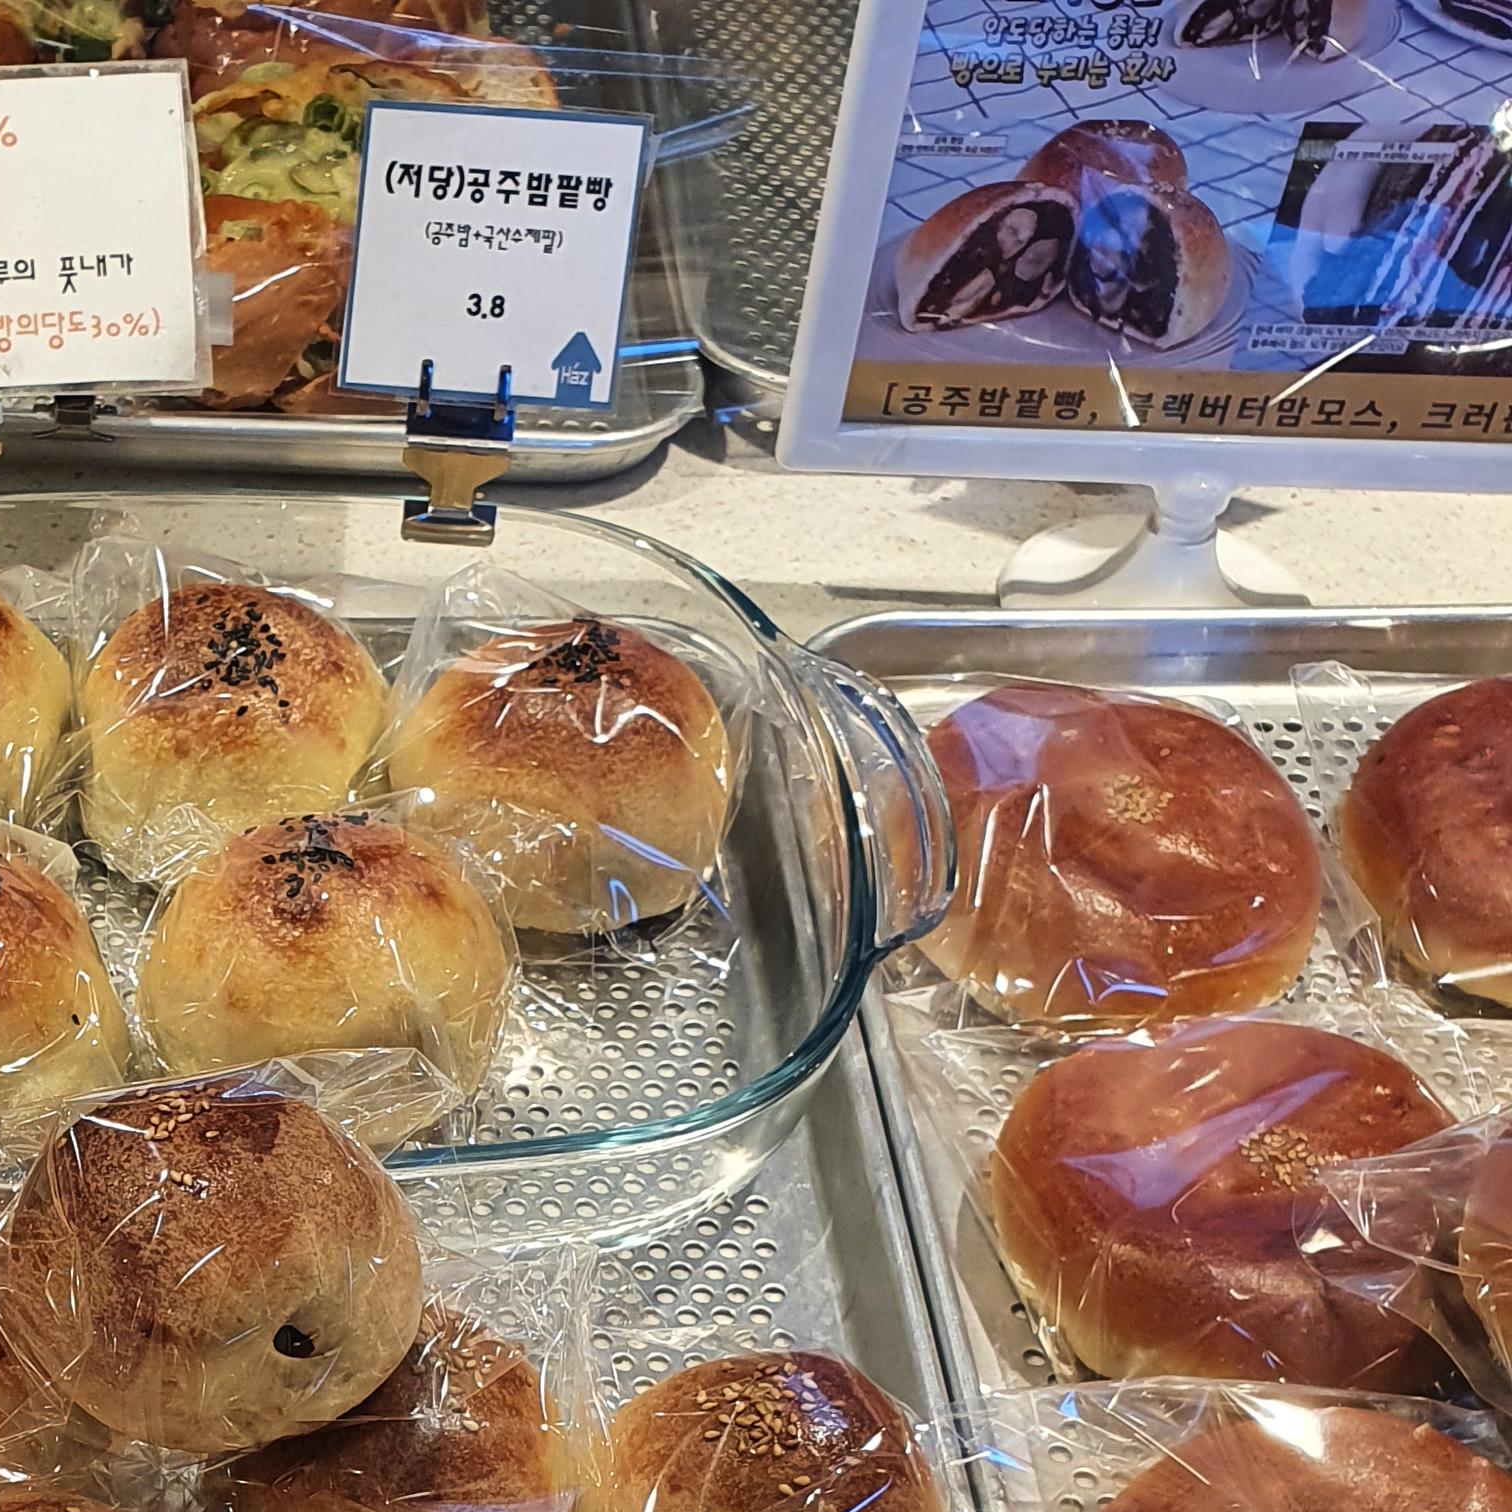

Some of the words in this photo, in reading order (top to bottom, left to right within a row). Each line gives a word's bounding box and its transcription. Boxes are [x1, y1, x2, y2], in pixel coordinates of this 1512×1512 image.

[983, 15, 1099, 48] 압도당하는
[1107, 14, 1163, 49] 종류!
[949, 51, 1025, 88] 빵으로
[1037, 51, 1112, 90] 누리는
[1119, 51, 1178, 85] 호사
[384, 160, 614, 212] (저당)공주밤팥빵
[57, 253, 134, 295] 풋내가
[465, 292, 507, 320] 3.8
[881, 381, 1099, 426] [공주밤팥빵,
[1420, 401, 1512, 435] 크러
